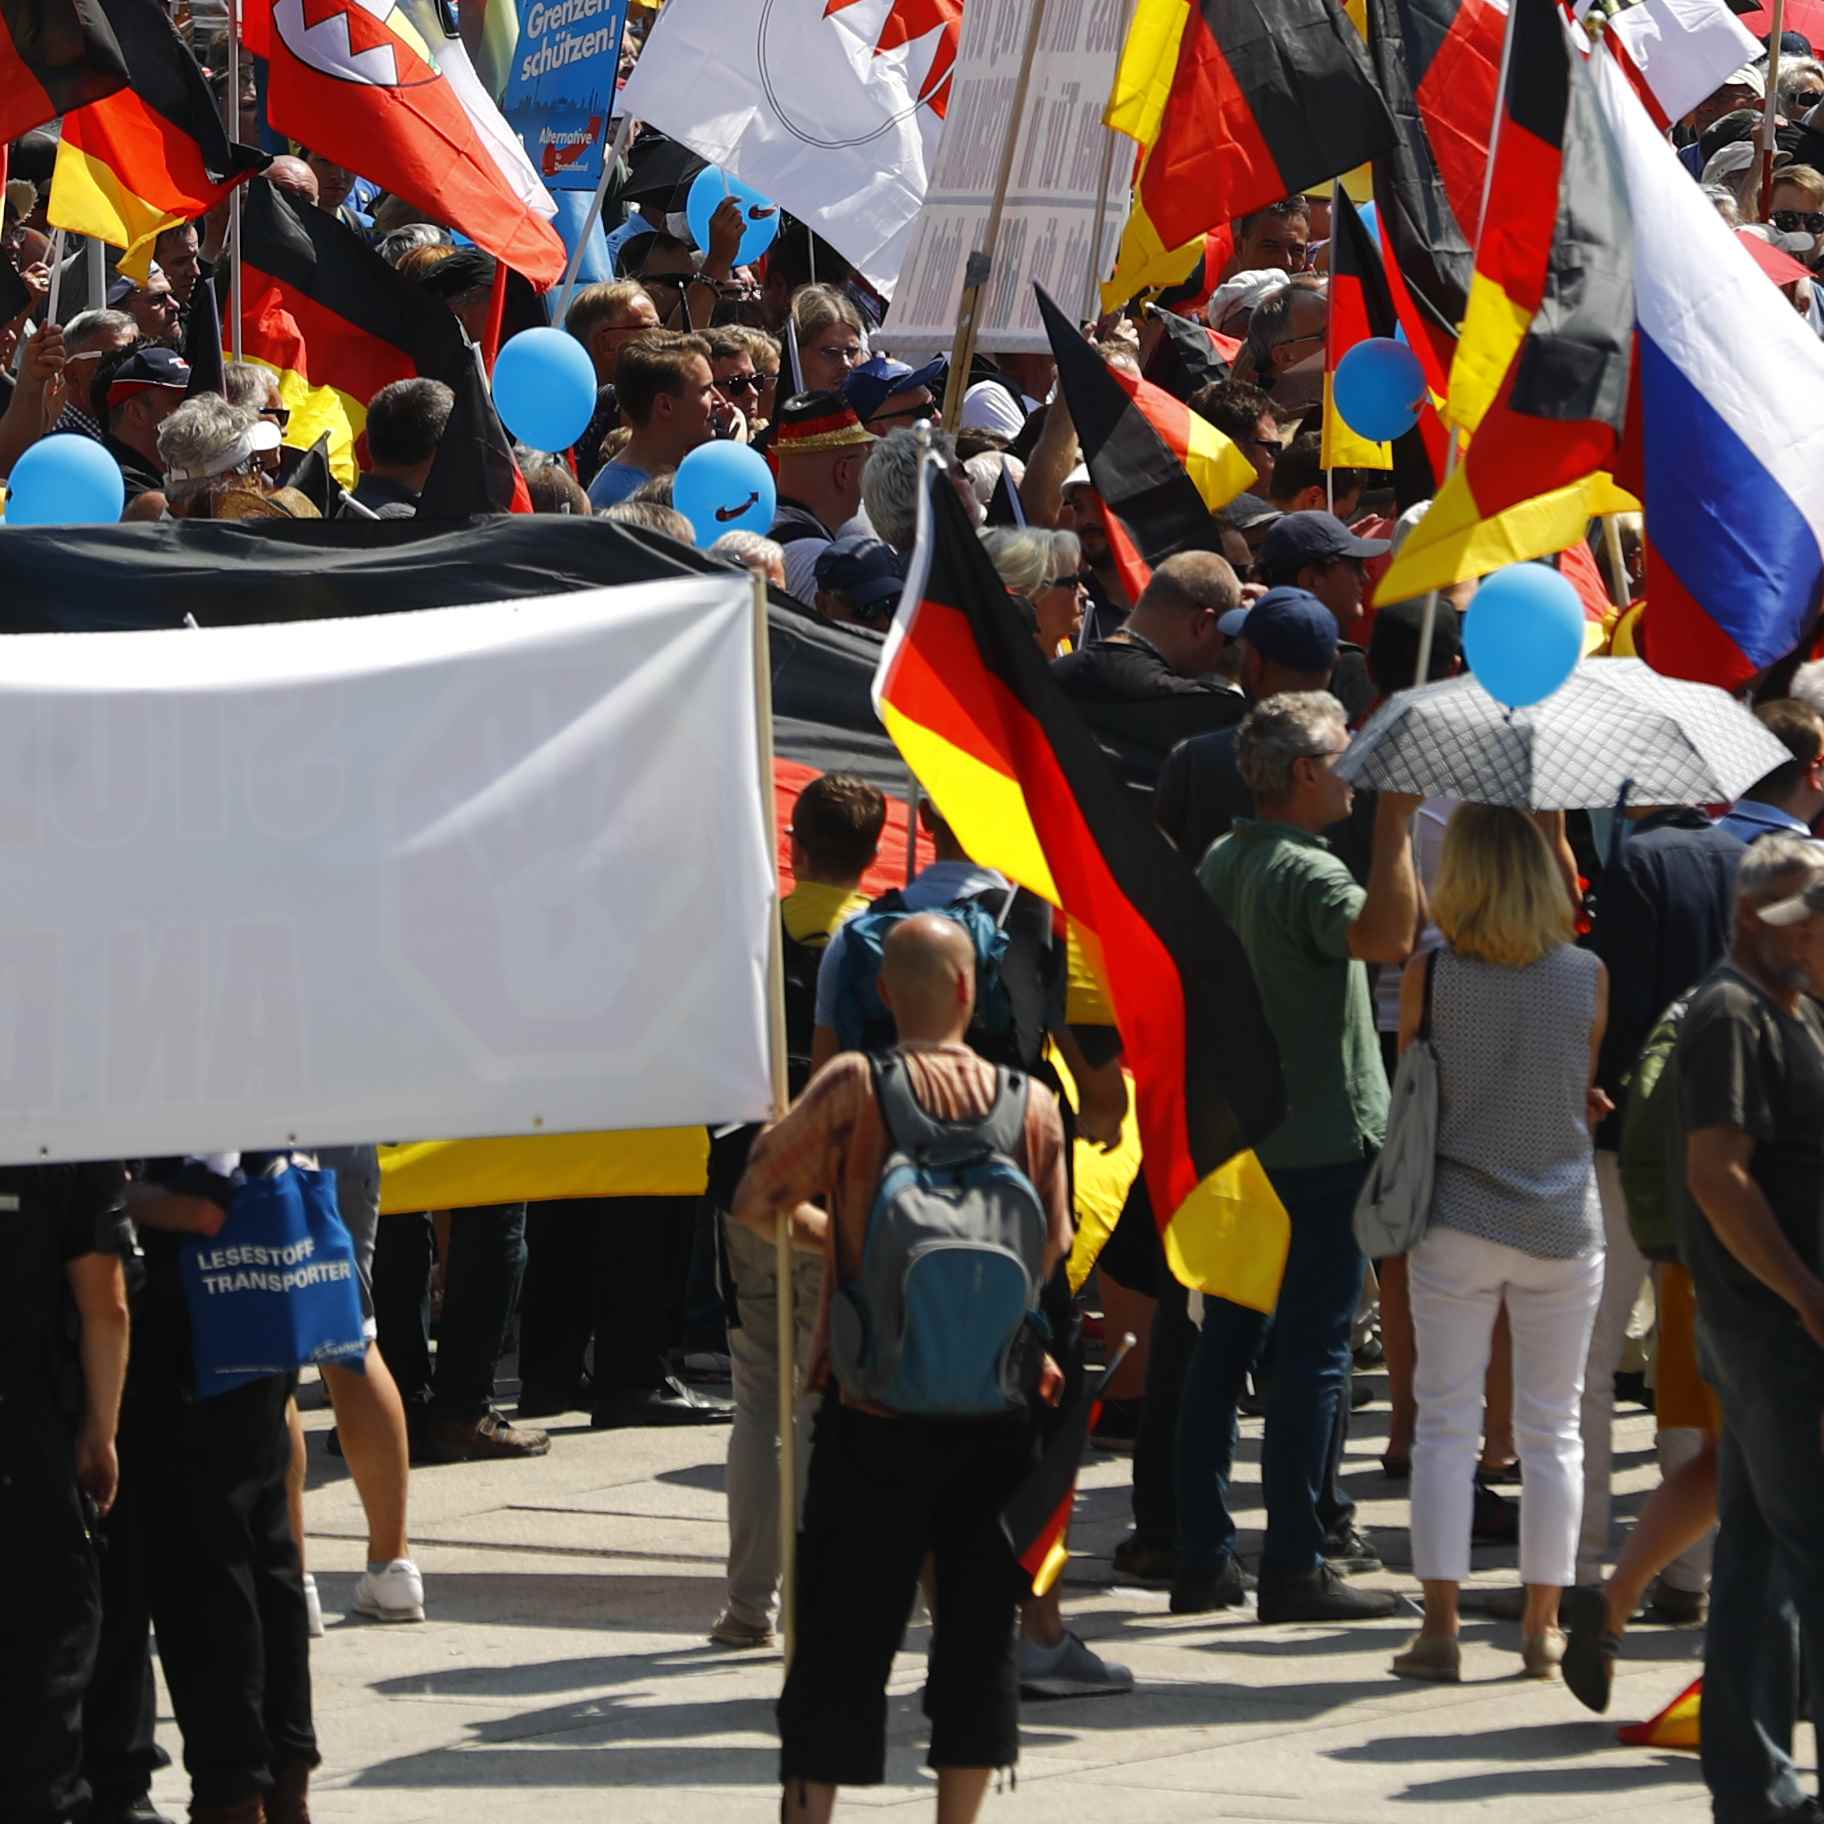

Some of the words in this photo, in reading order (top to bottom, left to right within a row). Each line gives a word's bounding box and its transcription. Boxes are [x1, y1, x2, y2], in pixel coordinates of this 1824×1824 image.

[521, 14, 616, 82] schützen!
[539, 126, 594, 146] Alternative
[197, 1236, 315, 1272] LESESTOFF
[201, 1260, 353, 1296] TRANSPORTER
